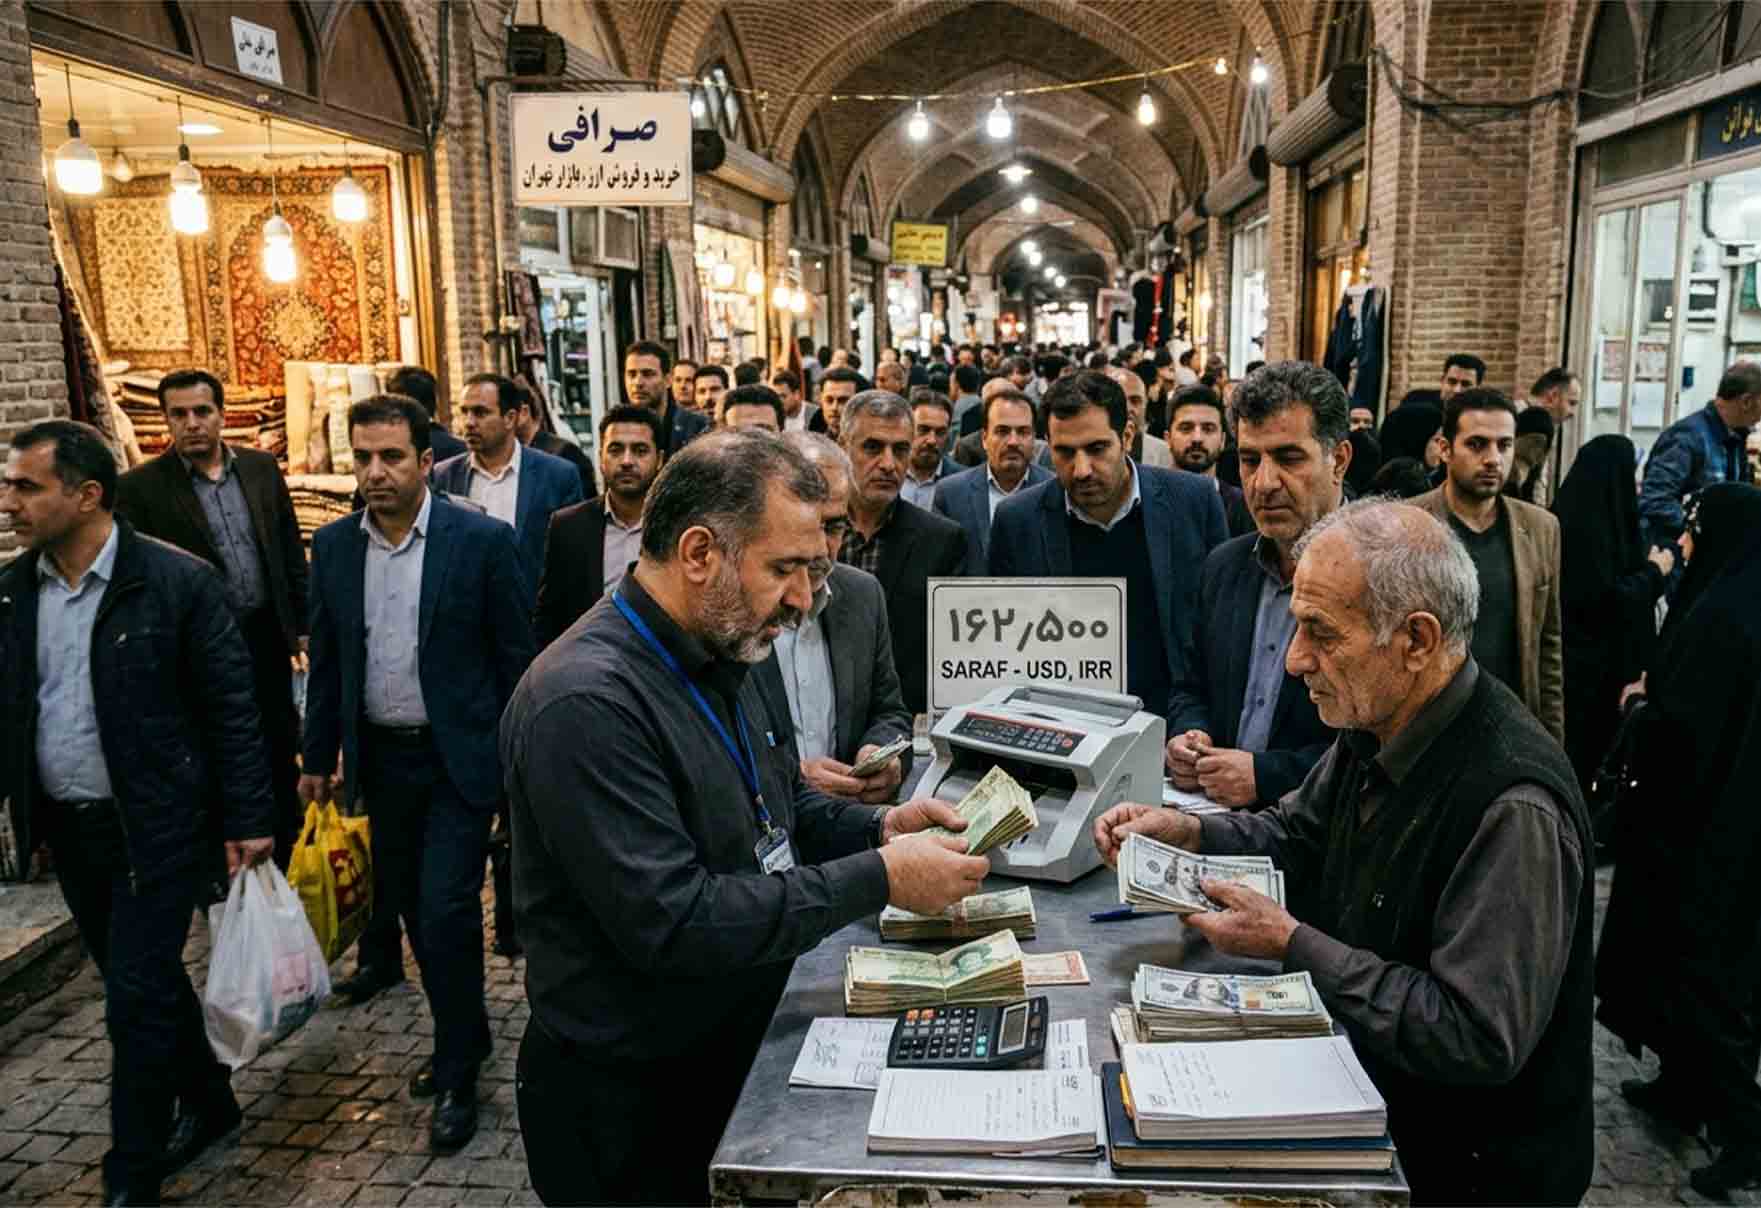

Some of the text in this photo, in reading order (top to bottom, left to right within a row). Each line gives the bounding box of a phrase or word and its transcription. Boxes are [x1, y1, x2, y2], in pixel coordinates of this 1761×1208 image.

[547, 105, 657, 153] صرافی
[607, 161, 640, 189] فروش
[643, 171, 650, 189] و
[653, 161, 681, 189] خرید
[941, 659, 1009, 680] SARAF
[1026, 659, 1073, 682] USD,
[1079, 660, 1113, 680] IRR
